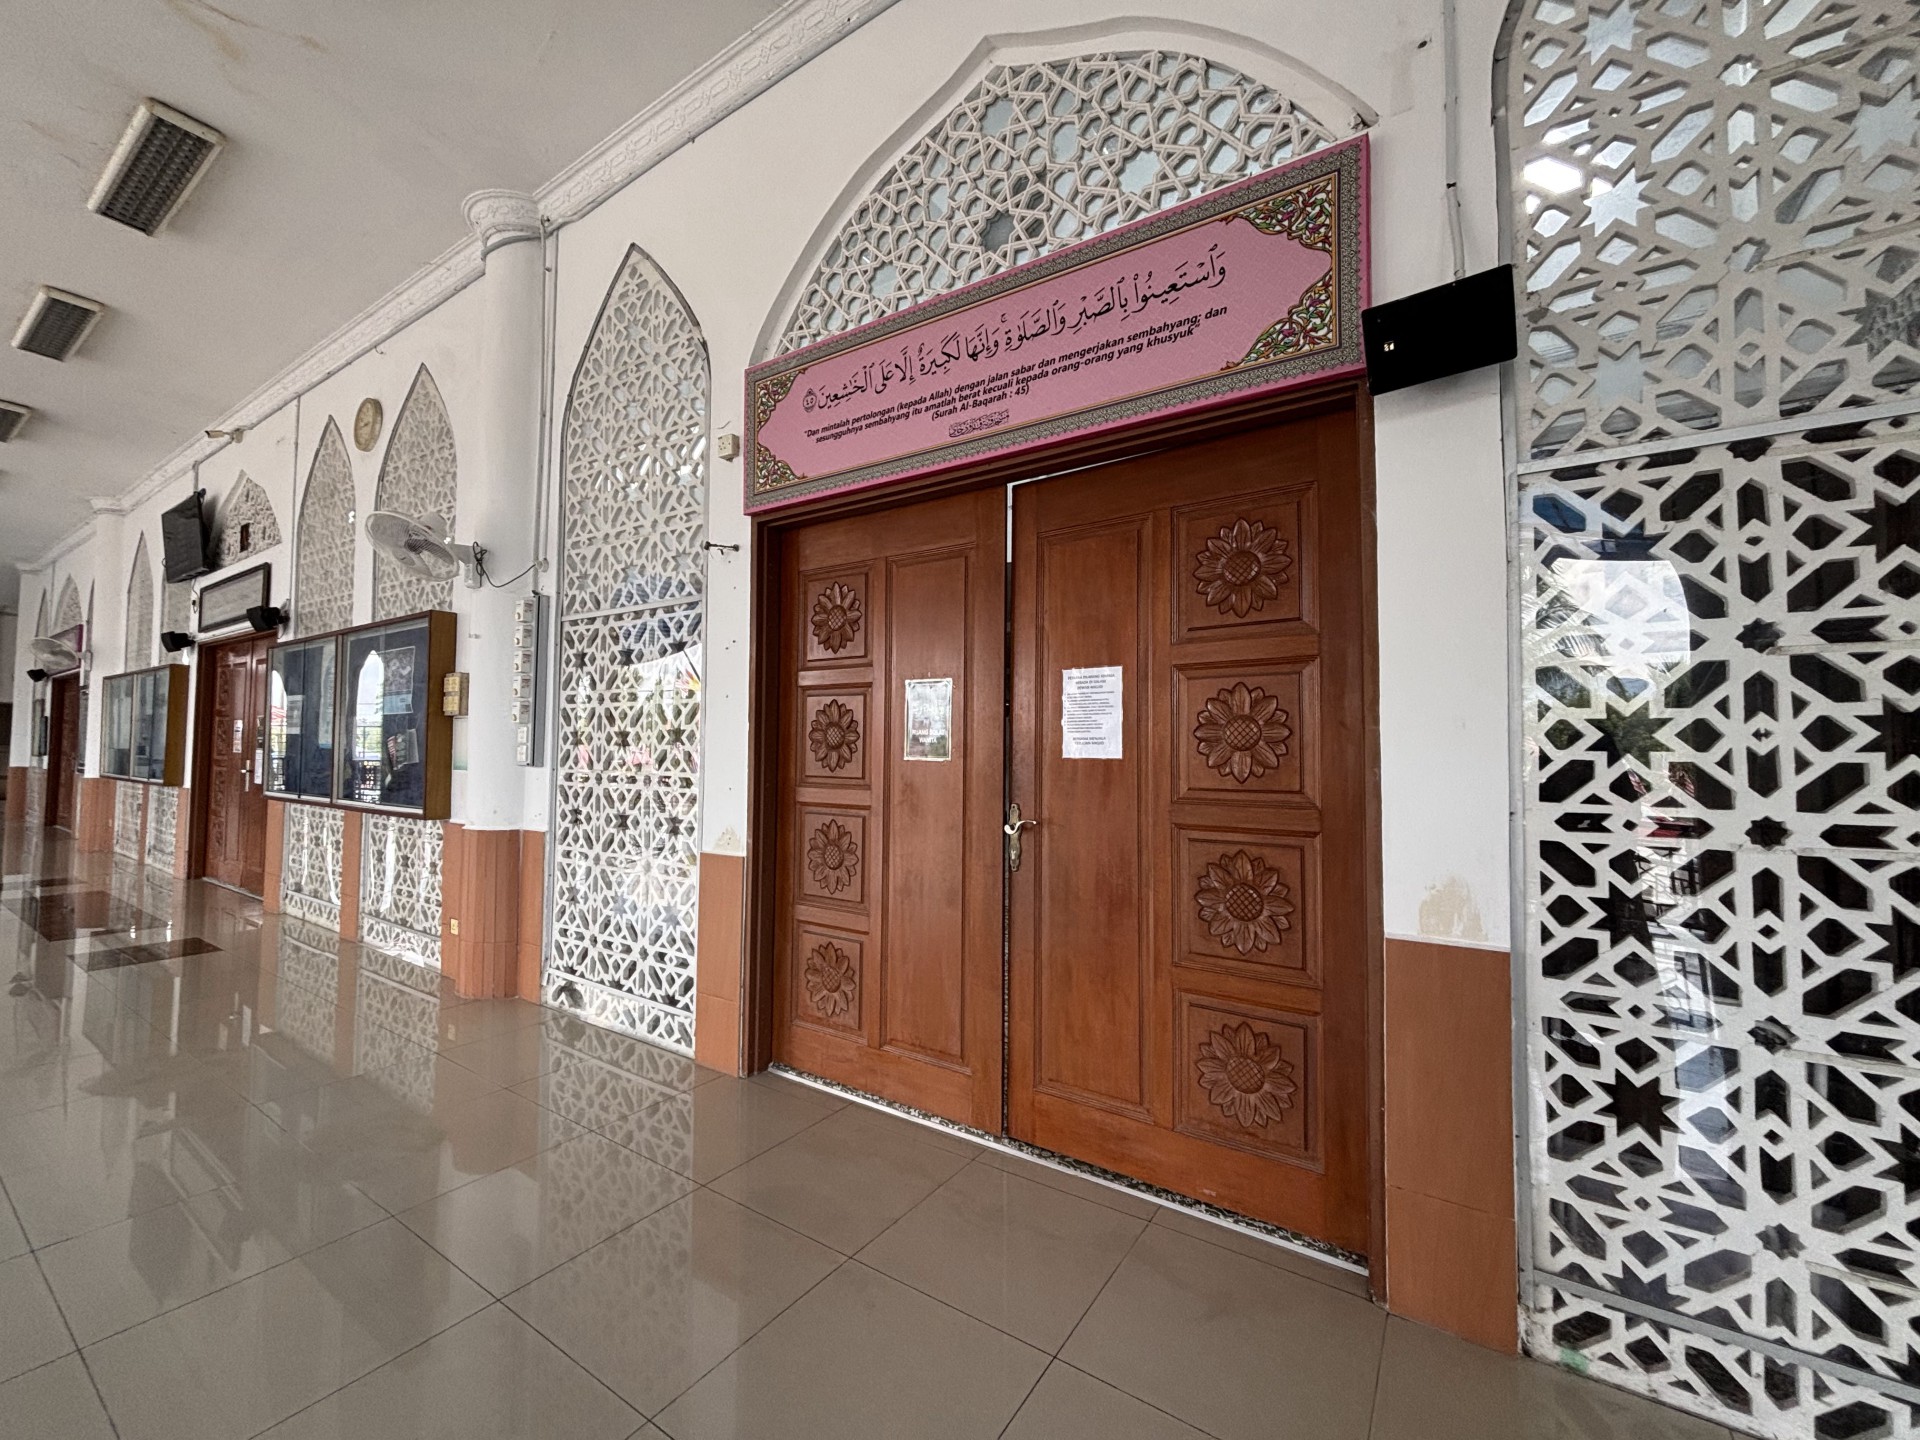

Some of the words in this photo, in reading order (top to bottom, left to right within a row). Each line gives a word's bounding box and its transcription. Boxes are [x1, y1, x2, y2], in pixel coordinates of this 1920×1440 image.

[815, 426, 863, 443] sesungguhnya
[864, 411, 910, 430] sembahyang
[911, 407, 923, 417] itu
[924, 396, 956, 413] amatlah
[958, 390, 981, 402] berat
[982, 378, 1013, 395] kecuali
[1015, 369, 1049, 387] kepada
[1051, 349, 1114, 376] orang-orang
[1116, 342, 1144, 359] yang
[820, 419, 850, 434] mintalah
[851, 405, 895, 427] pertolongan
[896, 395, 927, 411] (kepada
[928, 387, 953, 402] Allah)
[954, 377, 986, 395] dengan
[986, 371, 1009, 387] jalan
[1011, 363, 1036, 377] sabar
[1037, 356, 1056, 369] dan
[1058, 336, 1124, 364] mengerjakan
[1204, 306, 1228, 320] dan
[931, 402, 958, 421] (Surah
[959, 391, 1008, 412] Al-Baqarah
[1015, 384, 1030, 396] 45)
